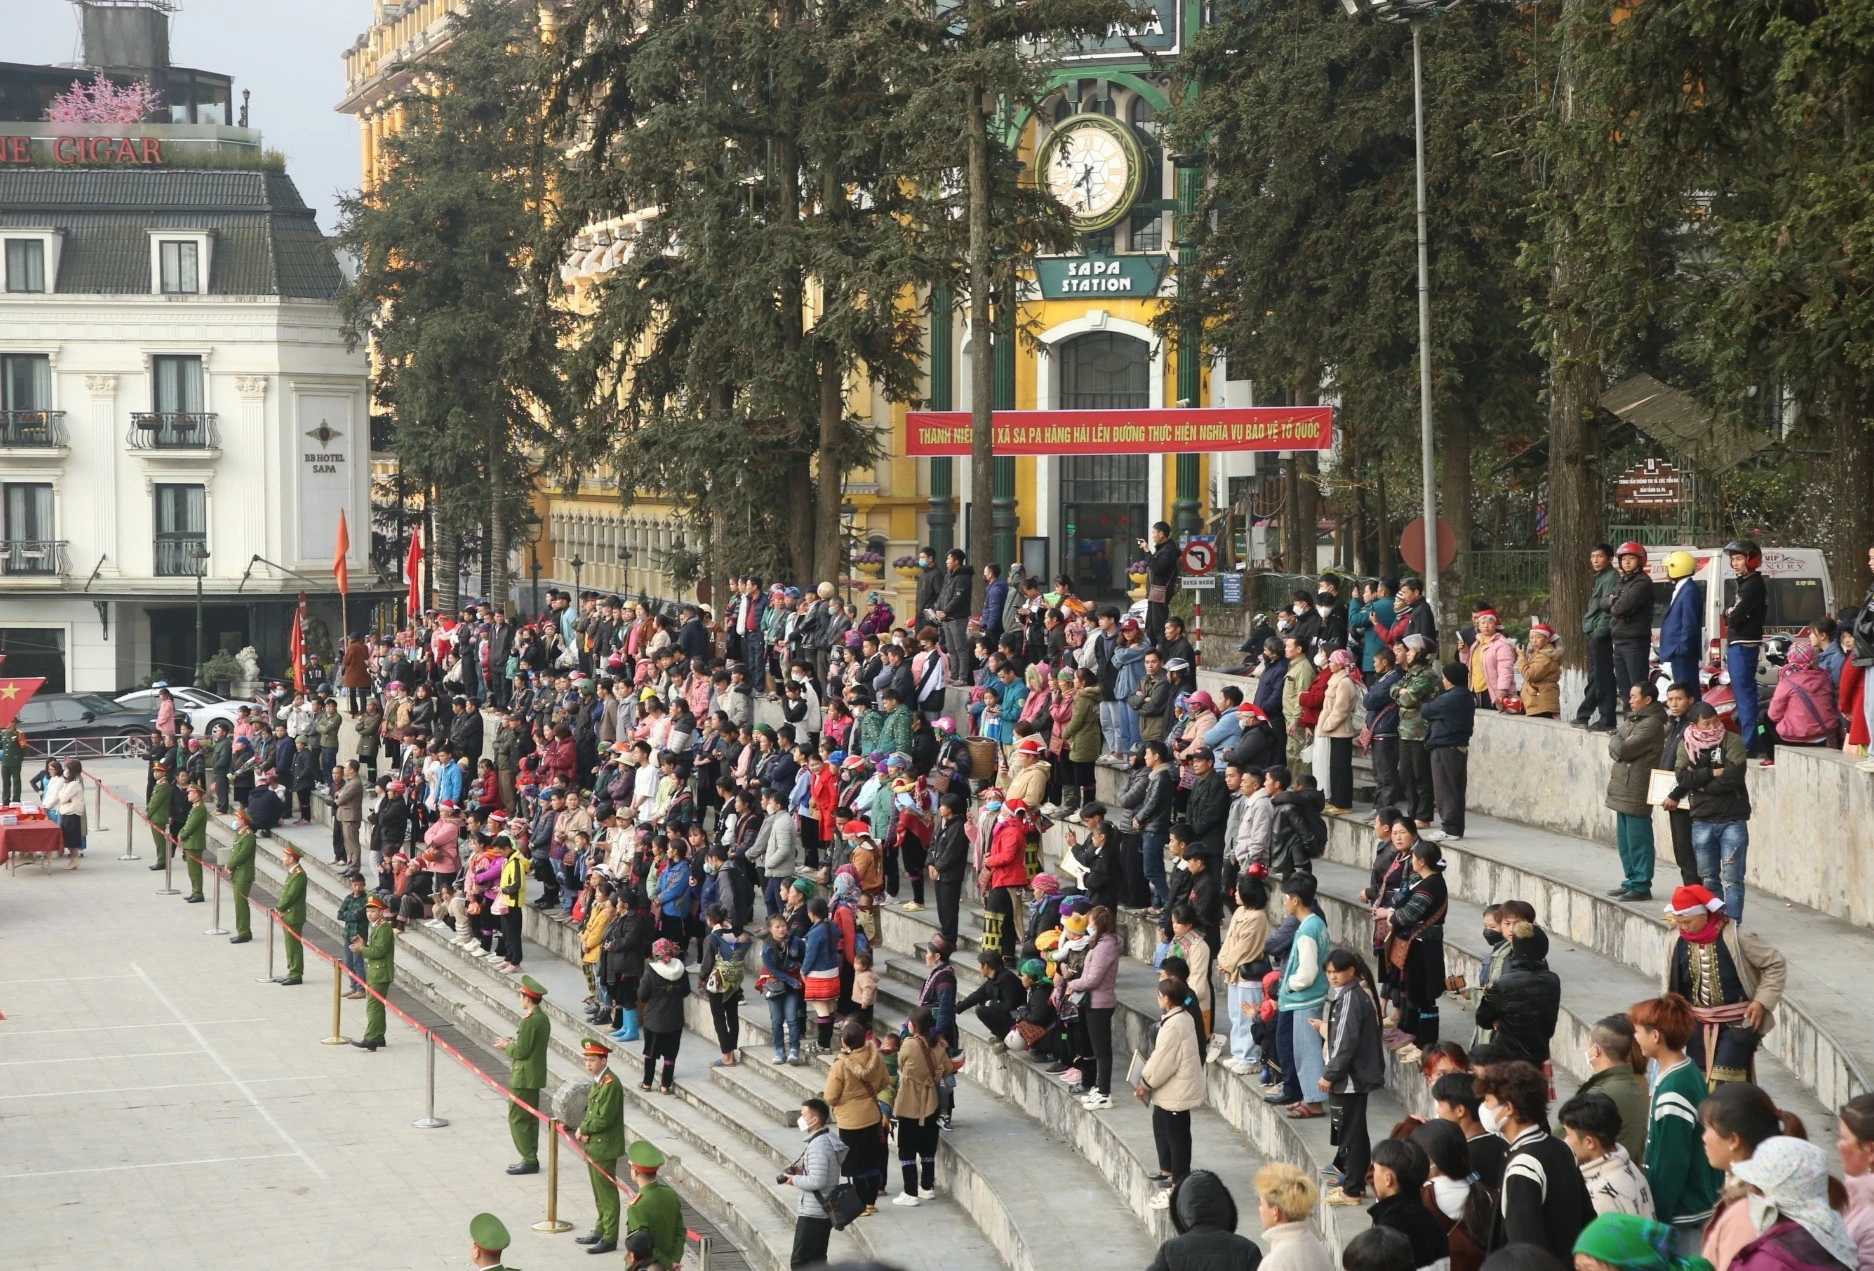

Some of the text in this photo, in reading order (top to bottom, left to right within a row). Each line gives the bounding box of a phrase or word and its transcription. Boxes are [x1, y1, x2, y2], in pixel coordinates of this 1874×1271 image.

[53, 136, 163, 164] CIGAR
[1068, 261, 1120, 276] SAPA
[1062, 277, 1131, 292] STATION
[919, 428, 951, 444] THANH
[954, 424, 973, 444] NIÊ
[997, 424, 1011, 444] XÃ
[1013, 427, 1027, 444] SA
[1029, 427, 1042, 443] PA
[1073, 423, 1090, 443] HÁI
[1092, 423, 1111, 442] LÊN
[1113, 421, 1145, 442] ĐƯỜNG
[1148, 424, 1172, 445] THỰC
[1174, 421, 1197, 445] HIỆN
[1199, 421, 1228, 441] NGHĨA
[1230, 423, 1243, 444] VỤ
[1245, 416, 1265, 440] BẢO
[1267, 420, 1279, 443] VỆ
[1281, 417, 1293, 439] TỔ
[1294, 416, 1320, 441] QUỐC
[316, 453, 345, 462] HOTEL
[312, 464, 337, 474] SAPA
